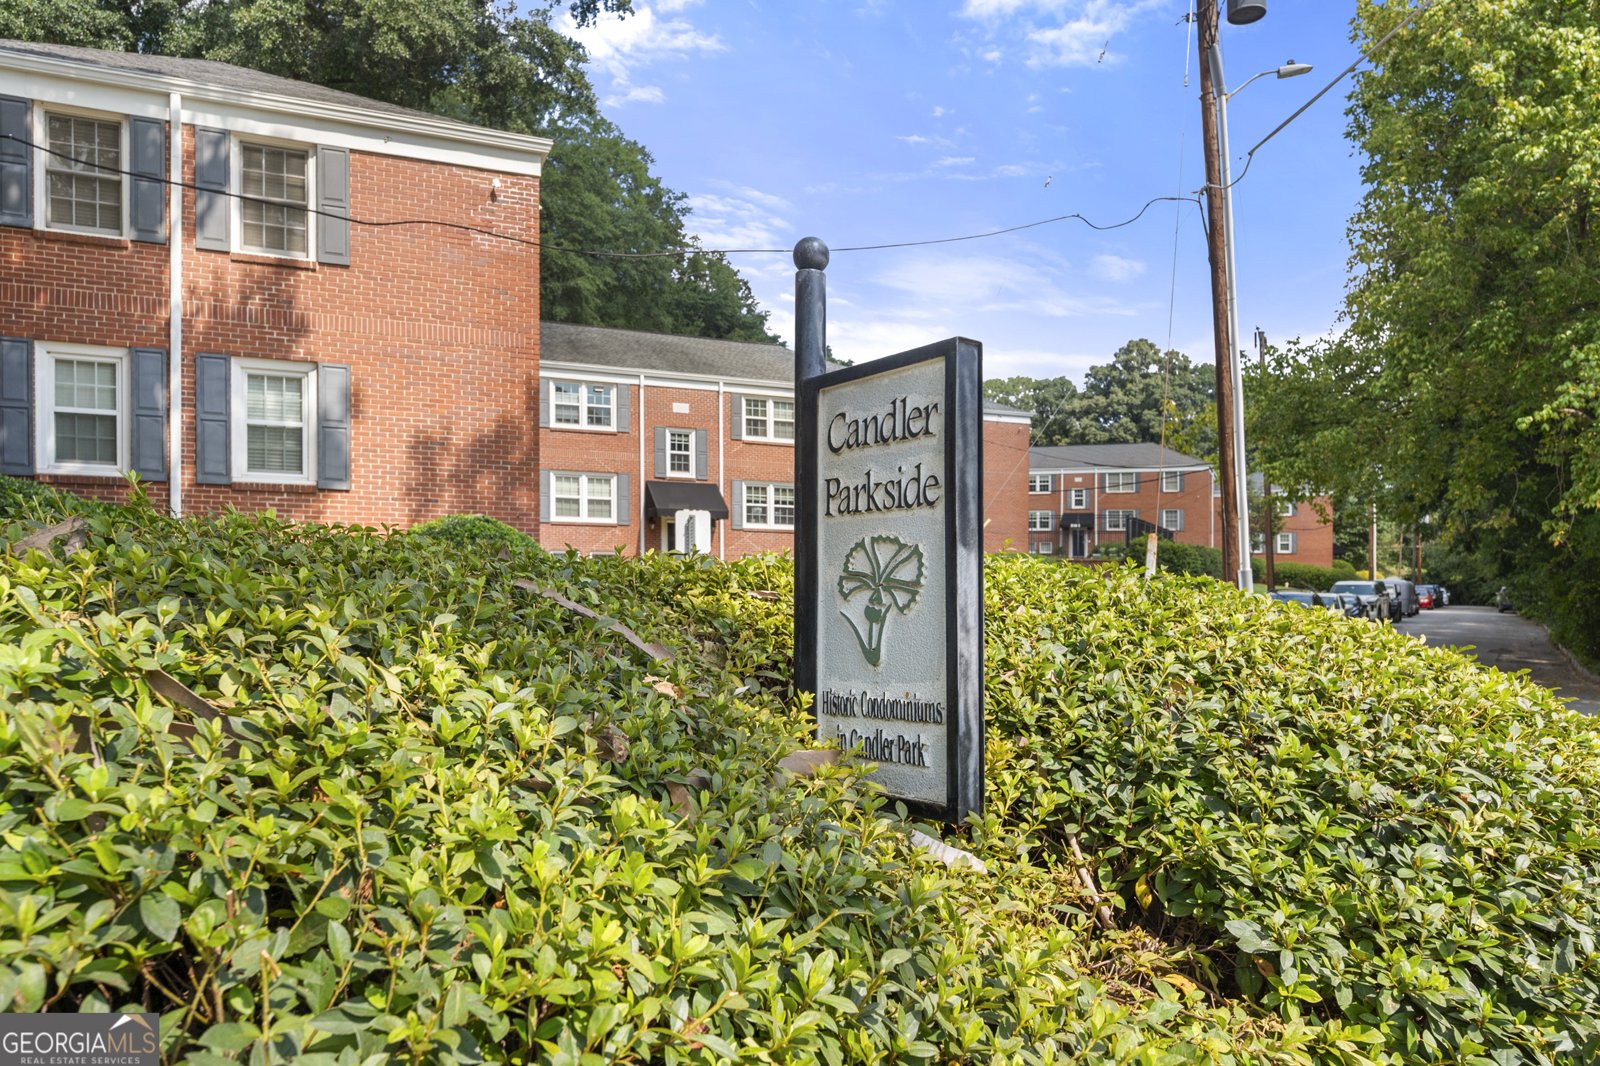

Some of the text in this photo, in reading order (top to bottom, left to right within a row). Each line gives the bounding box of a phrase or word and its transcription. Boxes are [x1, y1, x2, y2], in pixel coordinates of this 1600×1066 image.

[827, 396, 939, 454] Candler
[824, 462, 940, 517] Parkside
[822, 688, 944, 725] Historic Condominiums
[897, 734, 928, 767] Park
